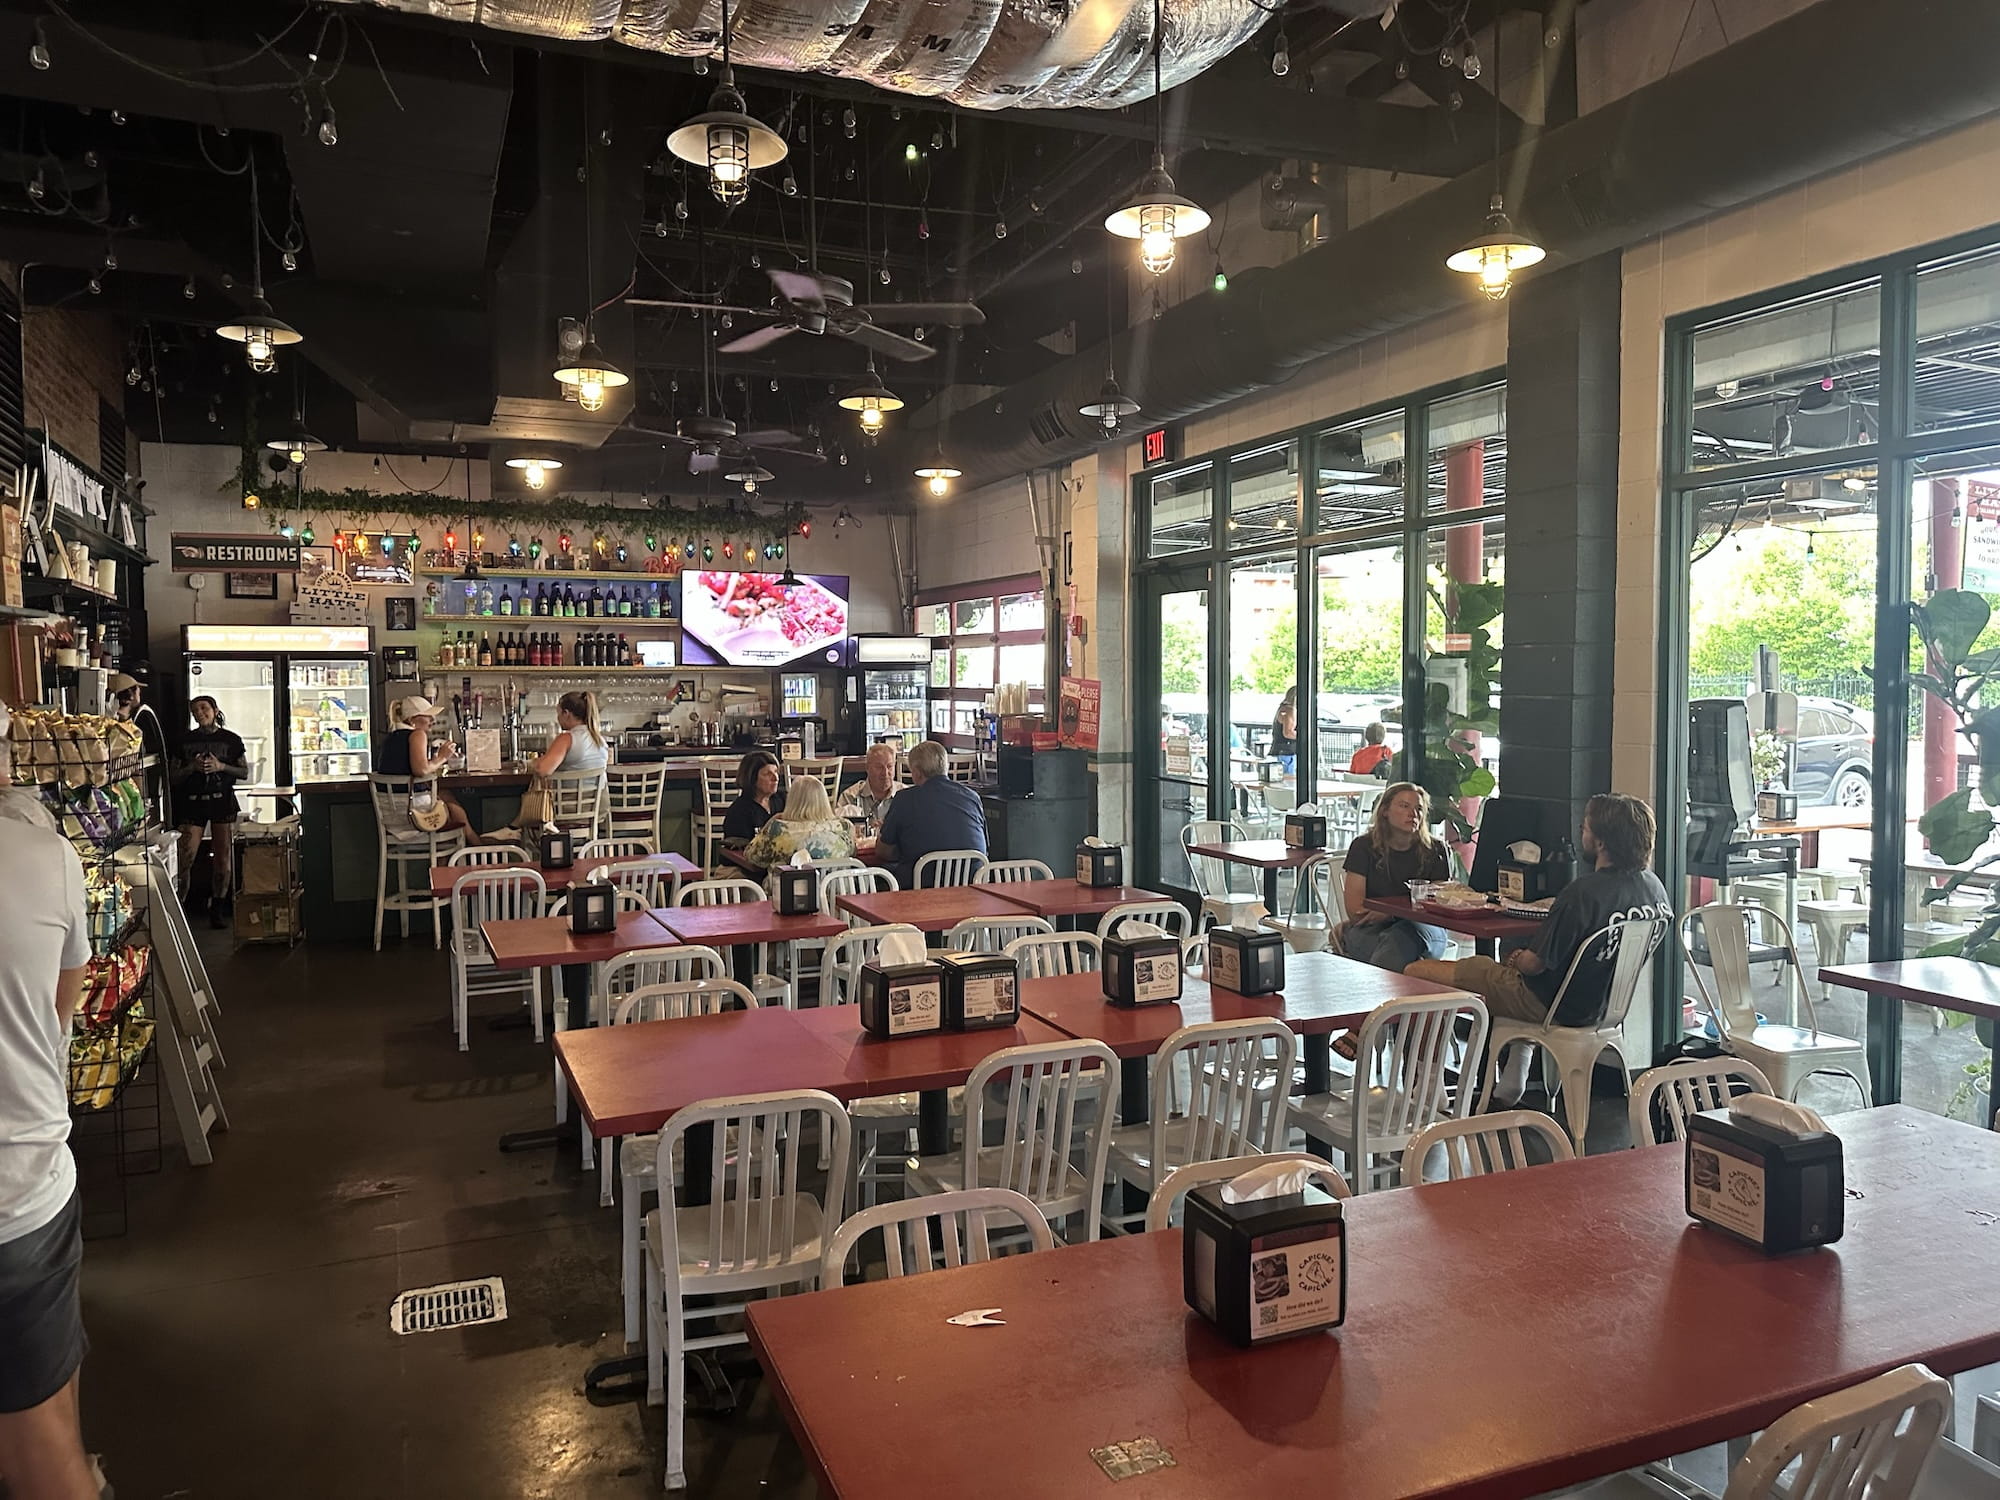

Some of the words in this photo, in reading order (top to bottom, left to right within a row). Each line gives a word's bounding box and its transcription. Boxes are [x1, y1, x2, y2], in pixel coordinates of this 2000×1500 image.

[1146, 430, 1165, 461] EXIT
[206, 545, 297, 561] RESTROOMS
[301, 587, 366, 600] LITTLE
[308, 597, 356, 608] HATS
